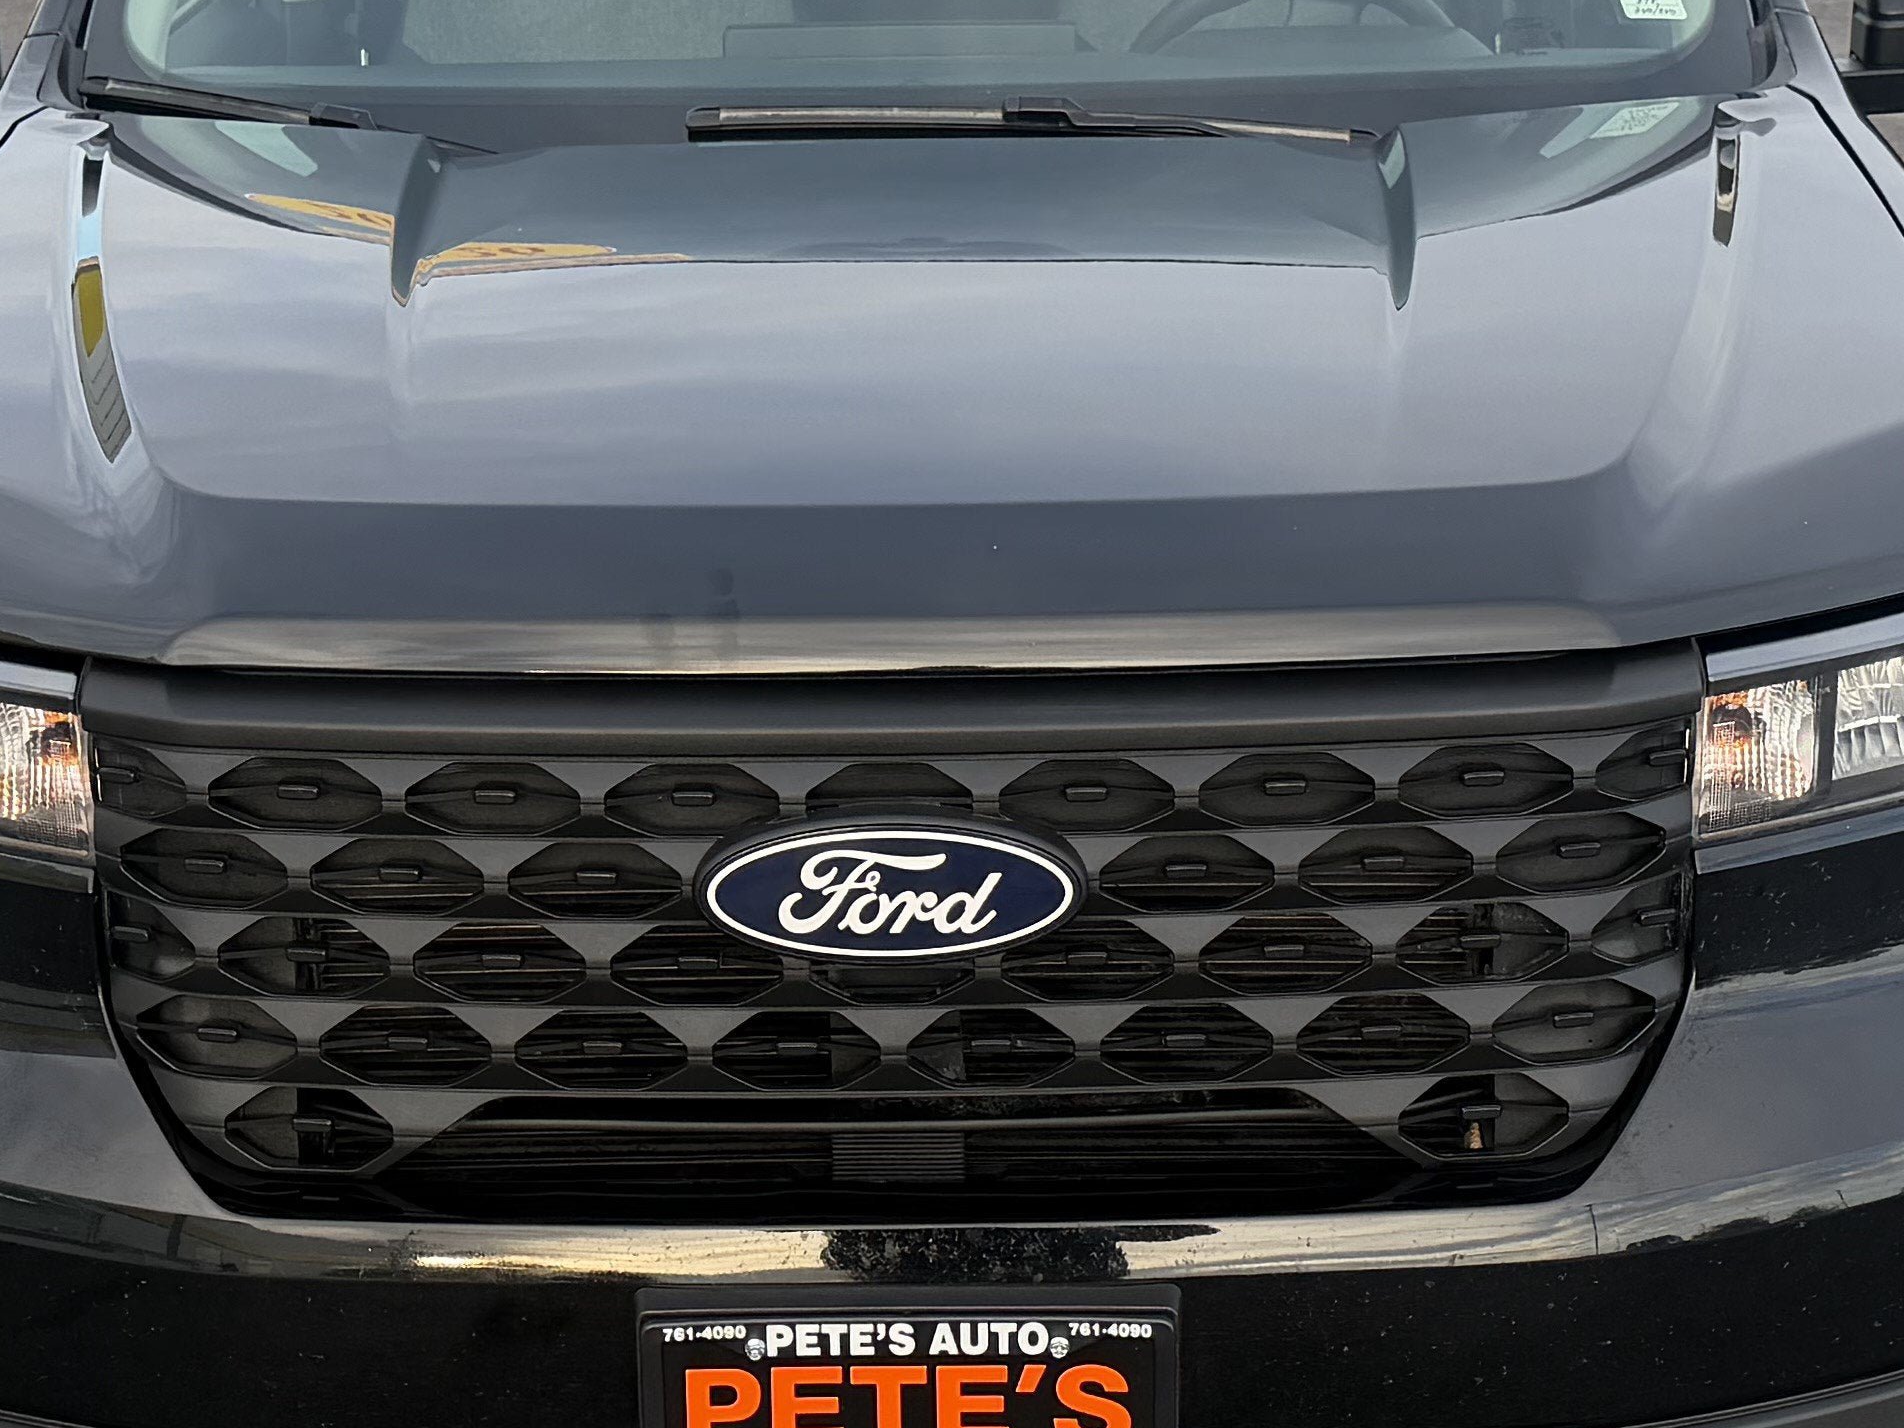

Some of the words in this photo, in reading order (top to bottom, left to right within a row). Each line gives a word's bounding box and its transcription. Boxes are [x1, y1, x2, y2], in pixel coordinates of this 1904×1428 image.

[777, 849, 1003, 935] Ford
[765, 1319, 916, 1358] PETE'S
[927, 1318, 1050, 1356] AUTO
